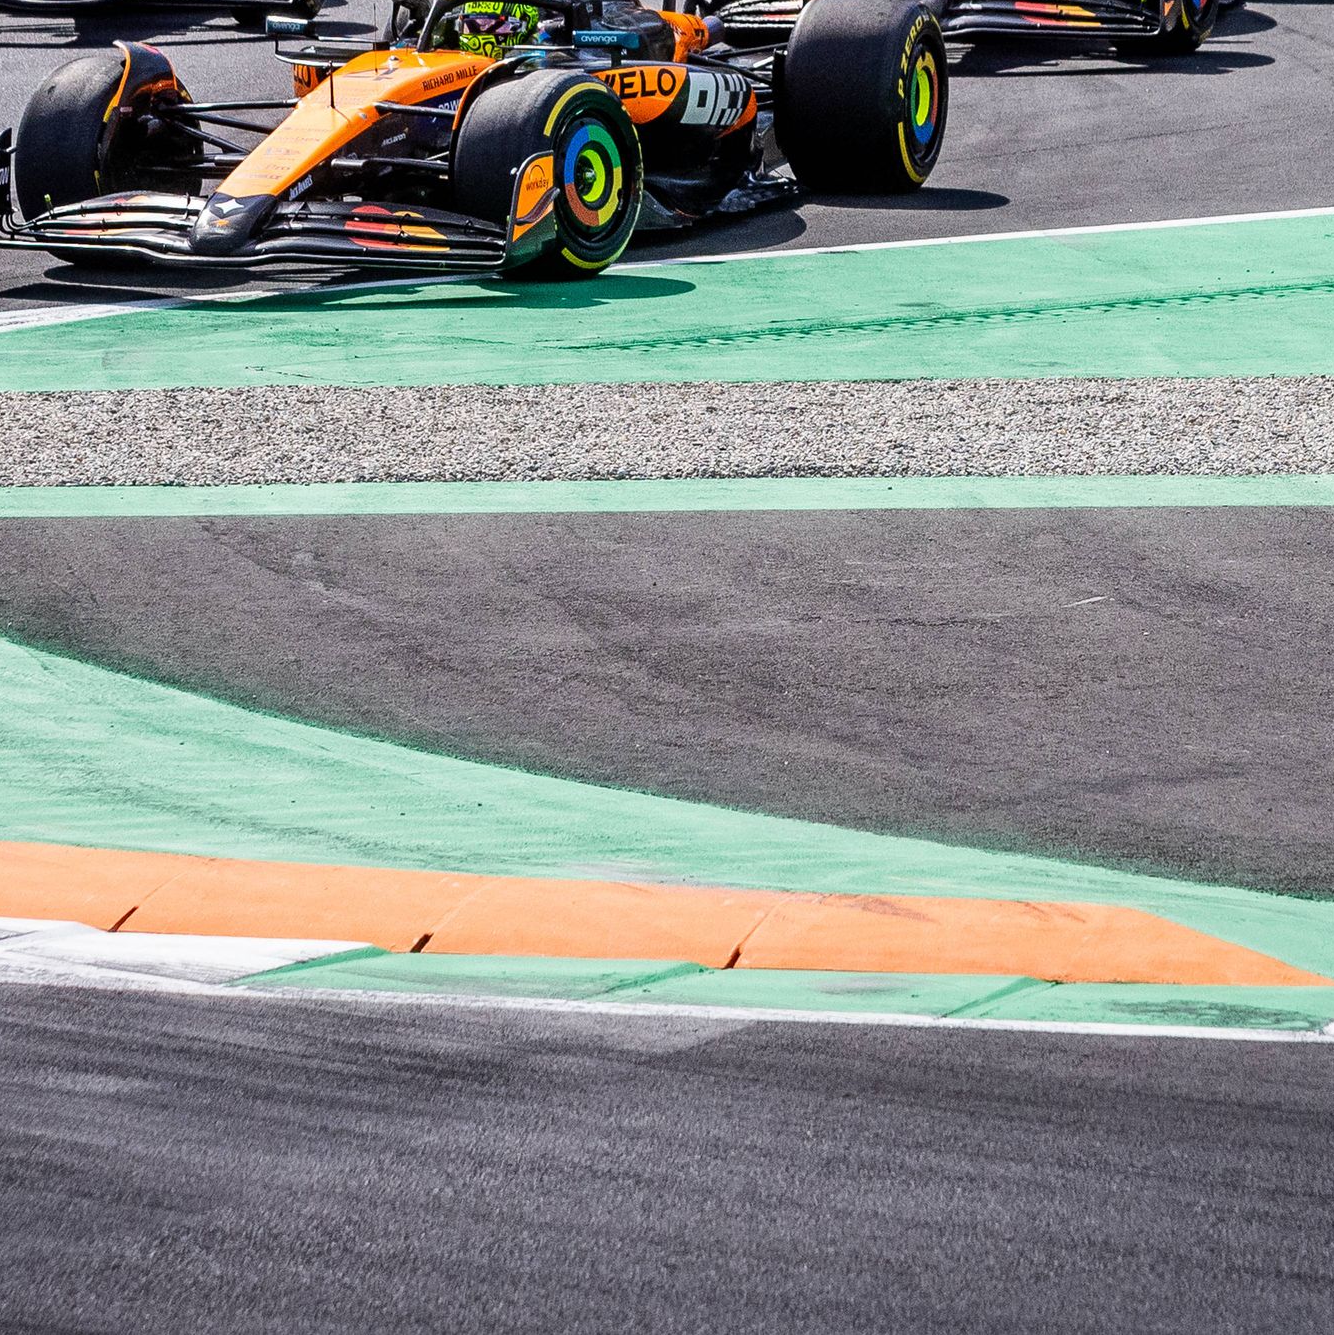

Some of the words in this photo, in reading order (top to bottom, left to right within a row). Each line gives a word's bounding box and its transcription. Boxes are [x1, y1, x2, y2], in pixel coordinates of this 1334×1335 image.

[271, 20, 302, 31] avenga
[580, 34, 617, 46] avenga
[897, 77, 905, 100] P
[901, 14, 923, 76] ZERO
[422, 72, 454, 92] RICHARD
[455, 65, 479, 84] MILLE
